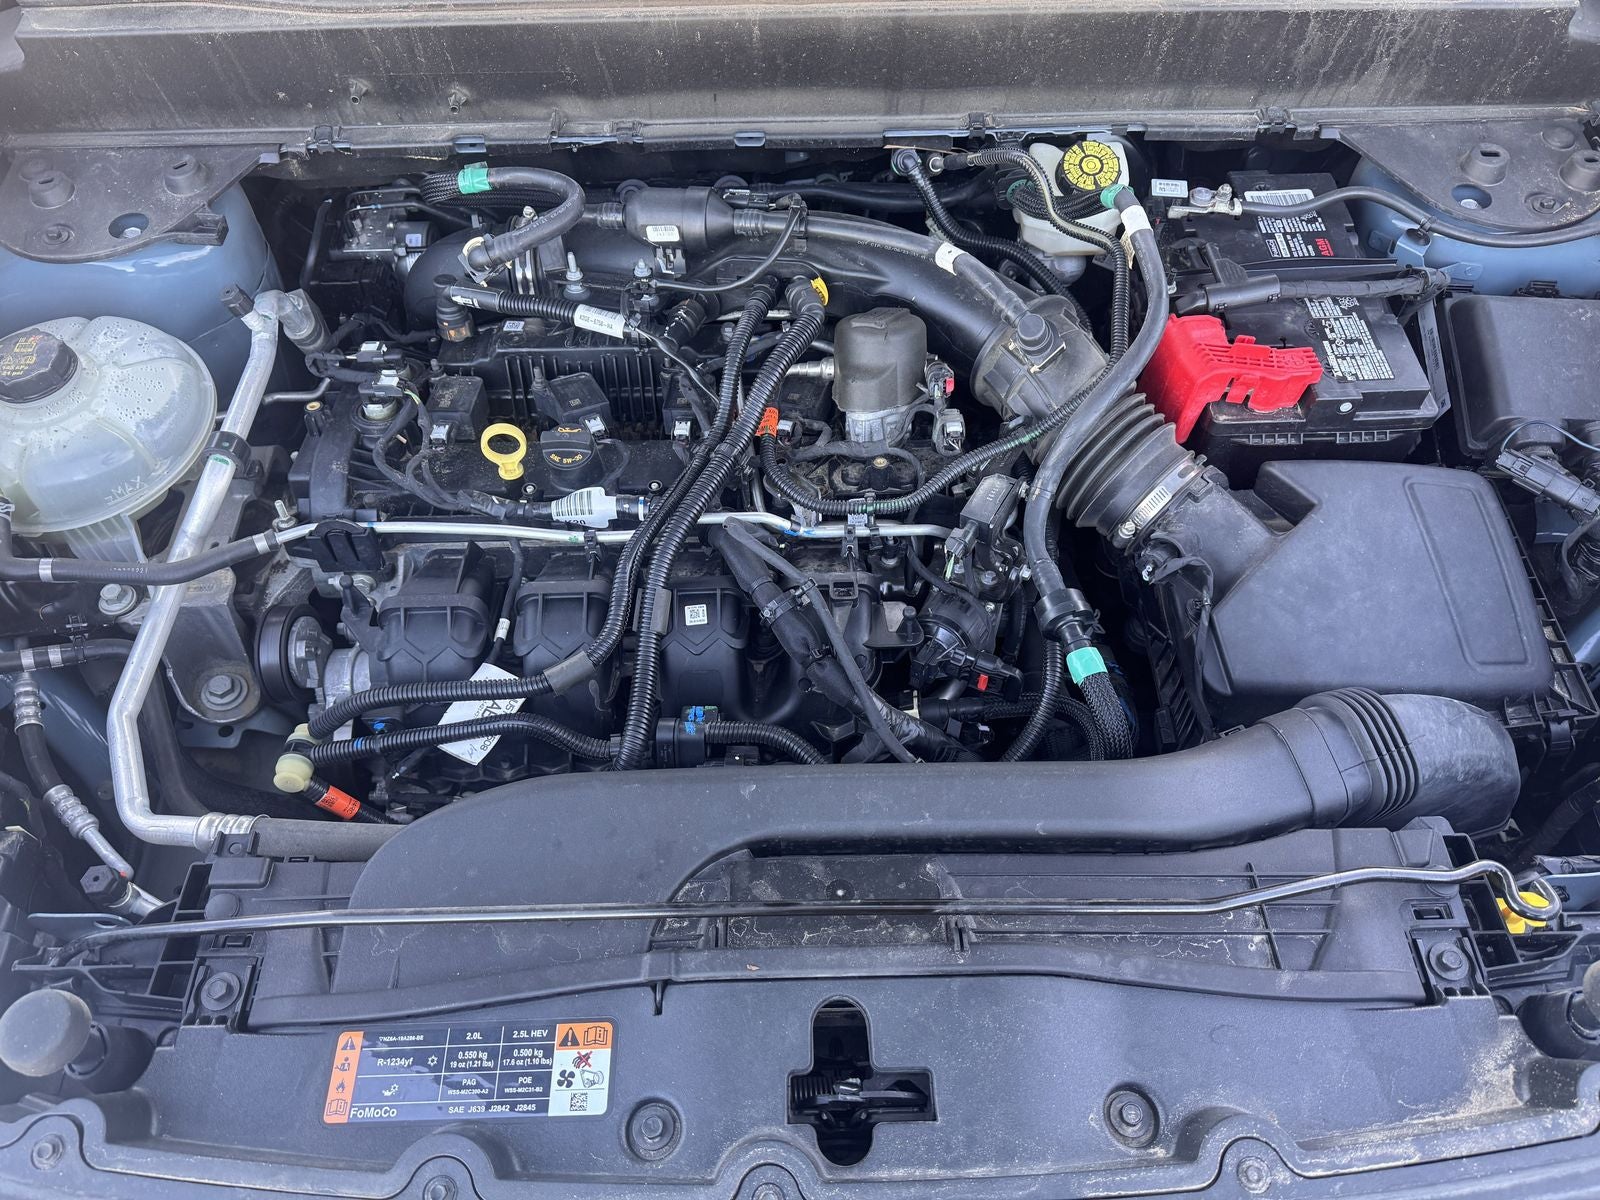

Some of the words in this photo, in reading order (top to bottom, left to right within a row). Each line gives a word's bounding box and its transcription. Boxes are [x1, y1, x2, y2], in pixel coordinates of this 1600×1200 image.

[1315, 238, 1331, 257] AGM
[466, 1032, 482, 1040] 2.0L
[512, 1030, 529, 1038] 2.5L
[531, 1029, 548, 1037] HEV
[458, 1051, 477, 1059] 0.550
[479, 1050, 488, 1060] kg
[513, 1049, 532, 1057] 0.500
[533, 1048, 543, 1057] kg
[377, 1057, 413, 1067] R-1234yf
[466, 1060, 480, 1069] (1.21
[482, 1060, 494, 1069] lbs)
[540, 1057, 552, 1066] lbs)
[462, 1078, 476, 1086] PAG
[518, 1076, 532, 1084] POE
[350, 1106, 397, 1118] FoMoCo
[468, 1105, 486, 1113] J639
[489, 1104, 511, 1112] J2842
[514, 1103, 536, 1112] J2845
